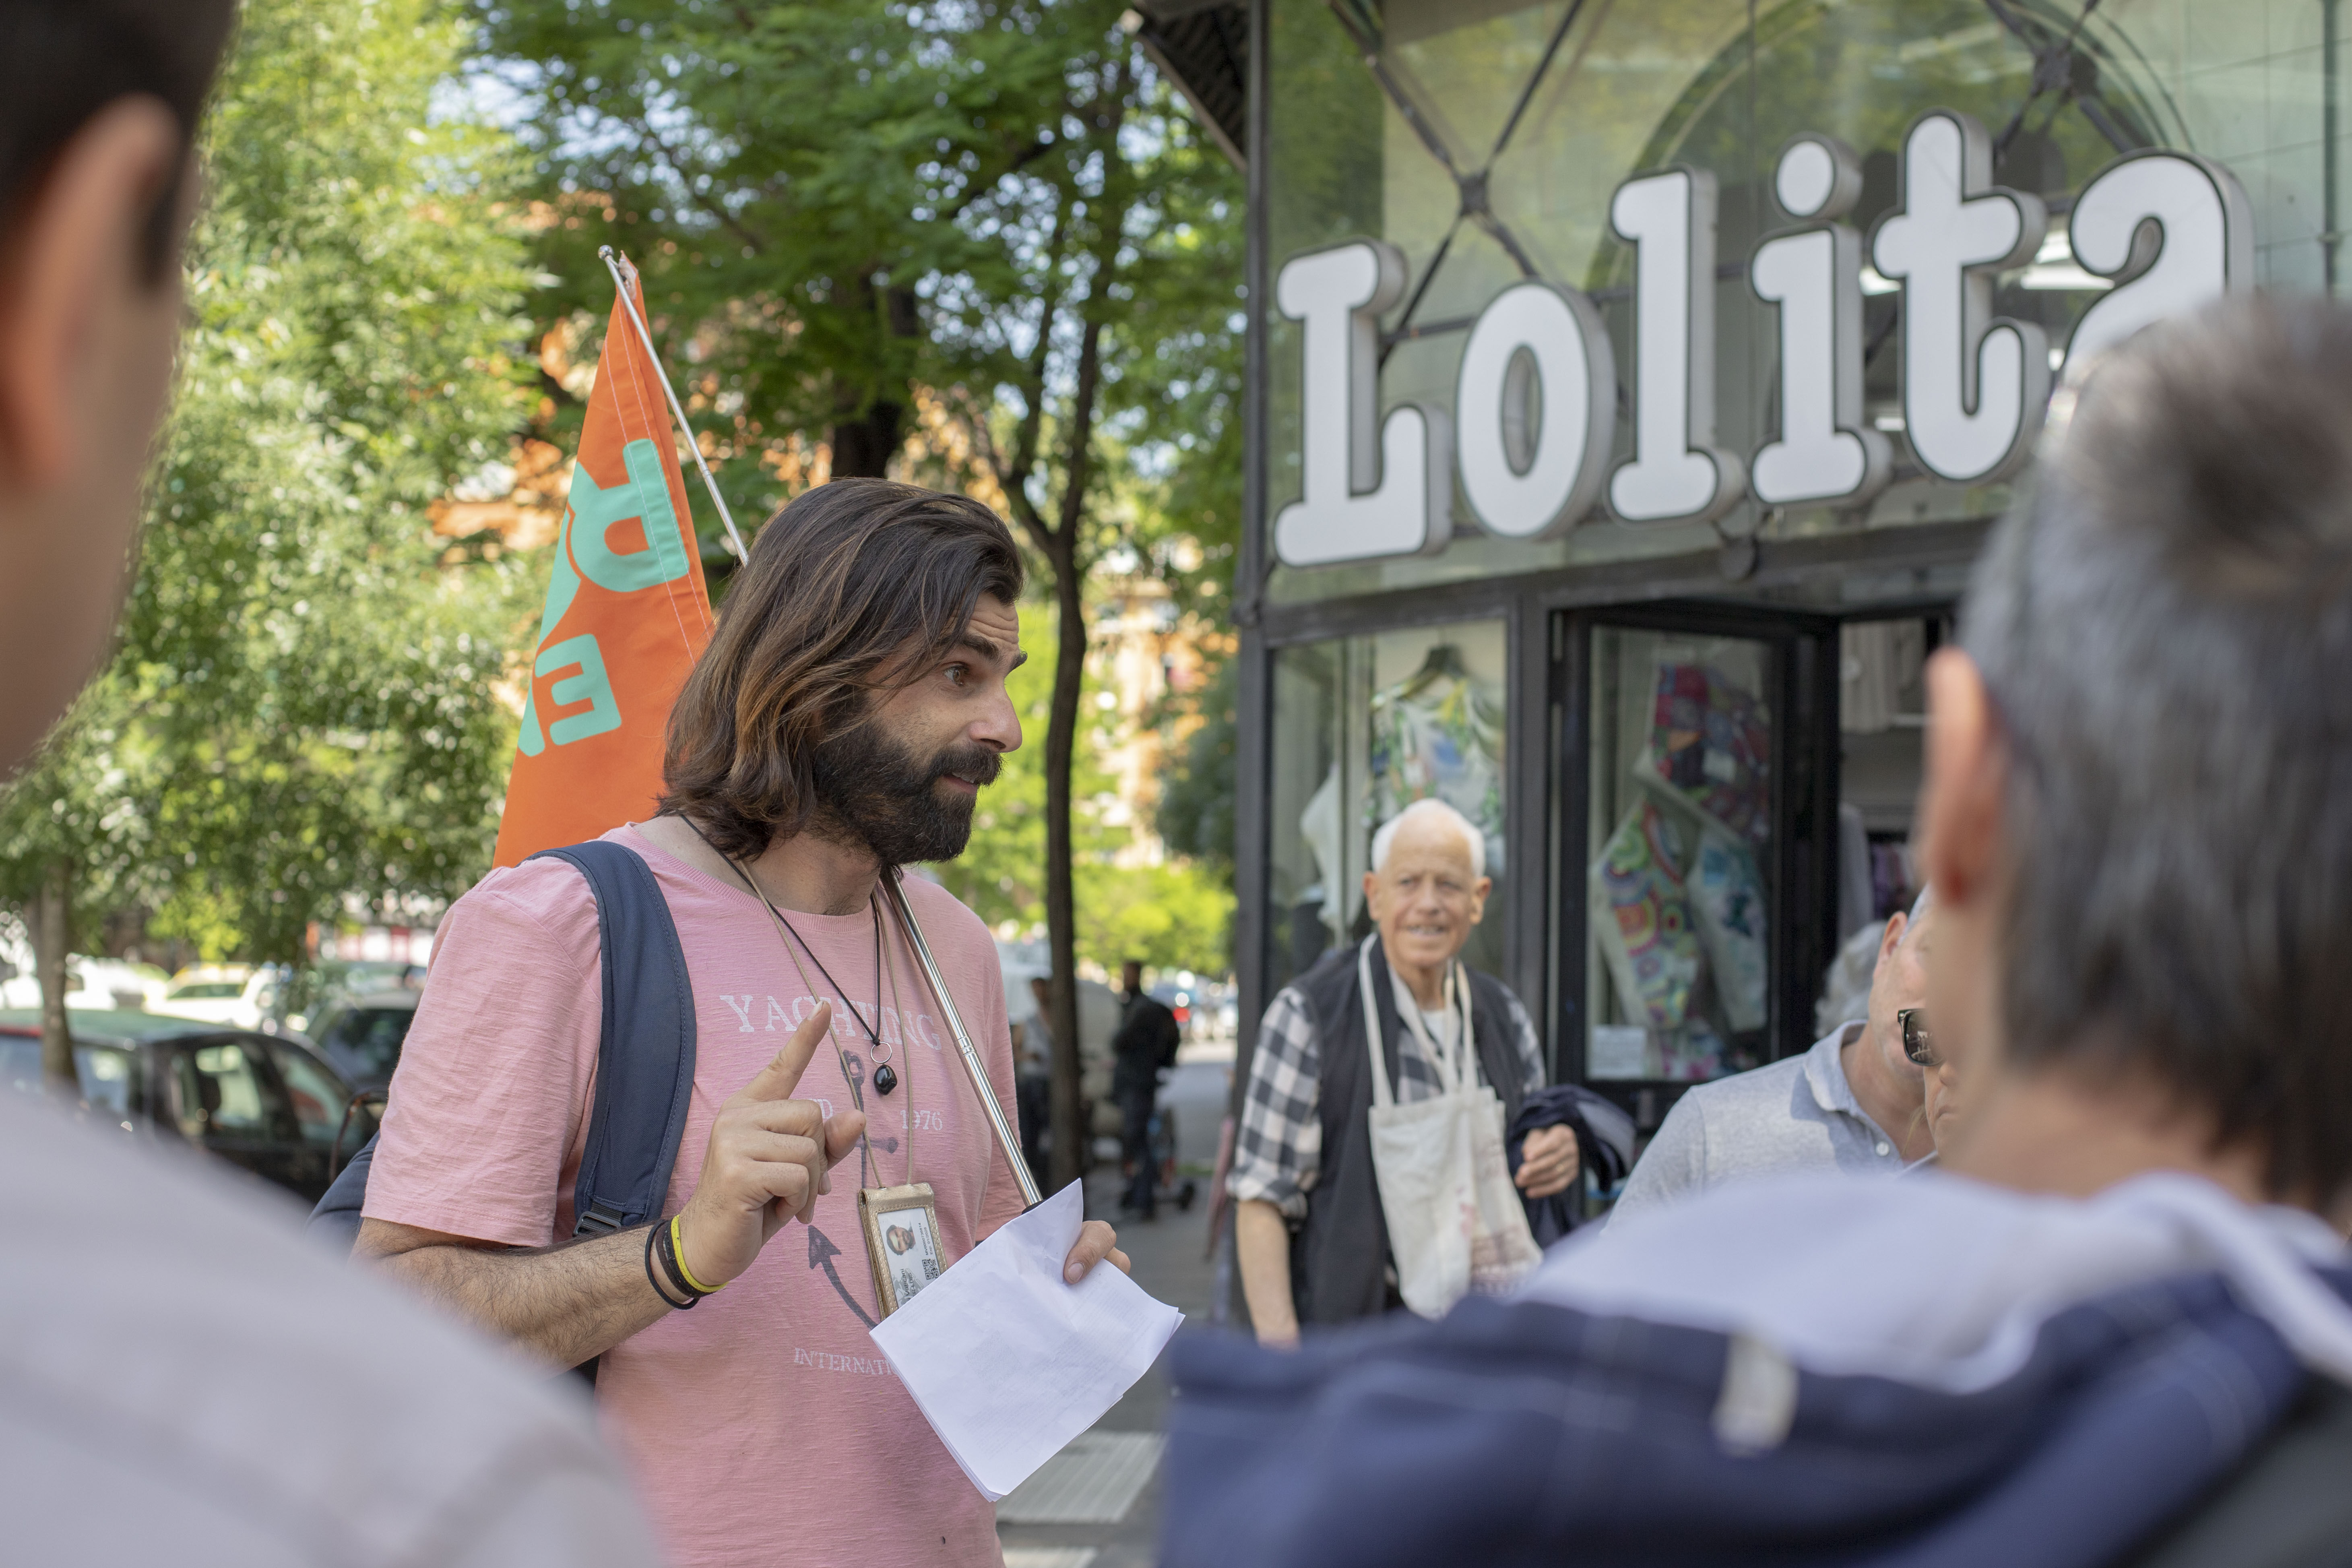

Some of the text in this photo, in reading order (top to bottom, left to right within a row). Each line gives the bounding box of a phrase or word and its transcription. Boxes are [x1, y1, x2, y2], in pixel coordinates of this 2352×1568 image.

[719, 995, 942, 1050] YACHTING
[900, 1268, 910, 1296] Vaticani
[793, 1347, 894, 1376] INTERNATI
